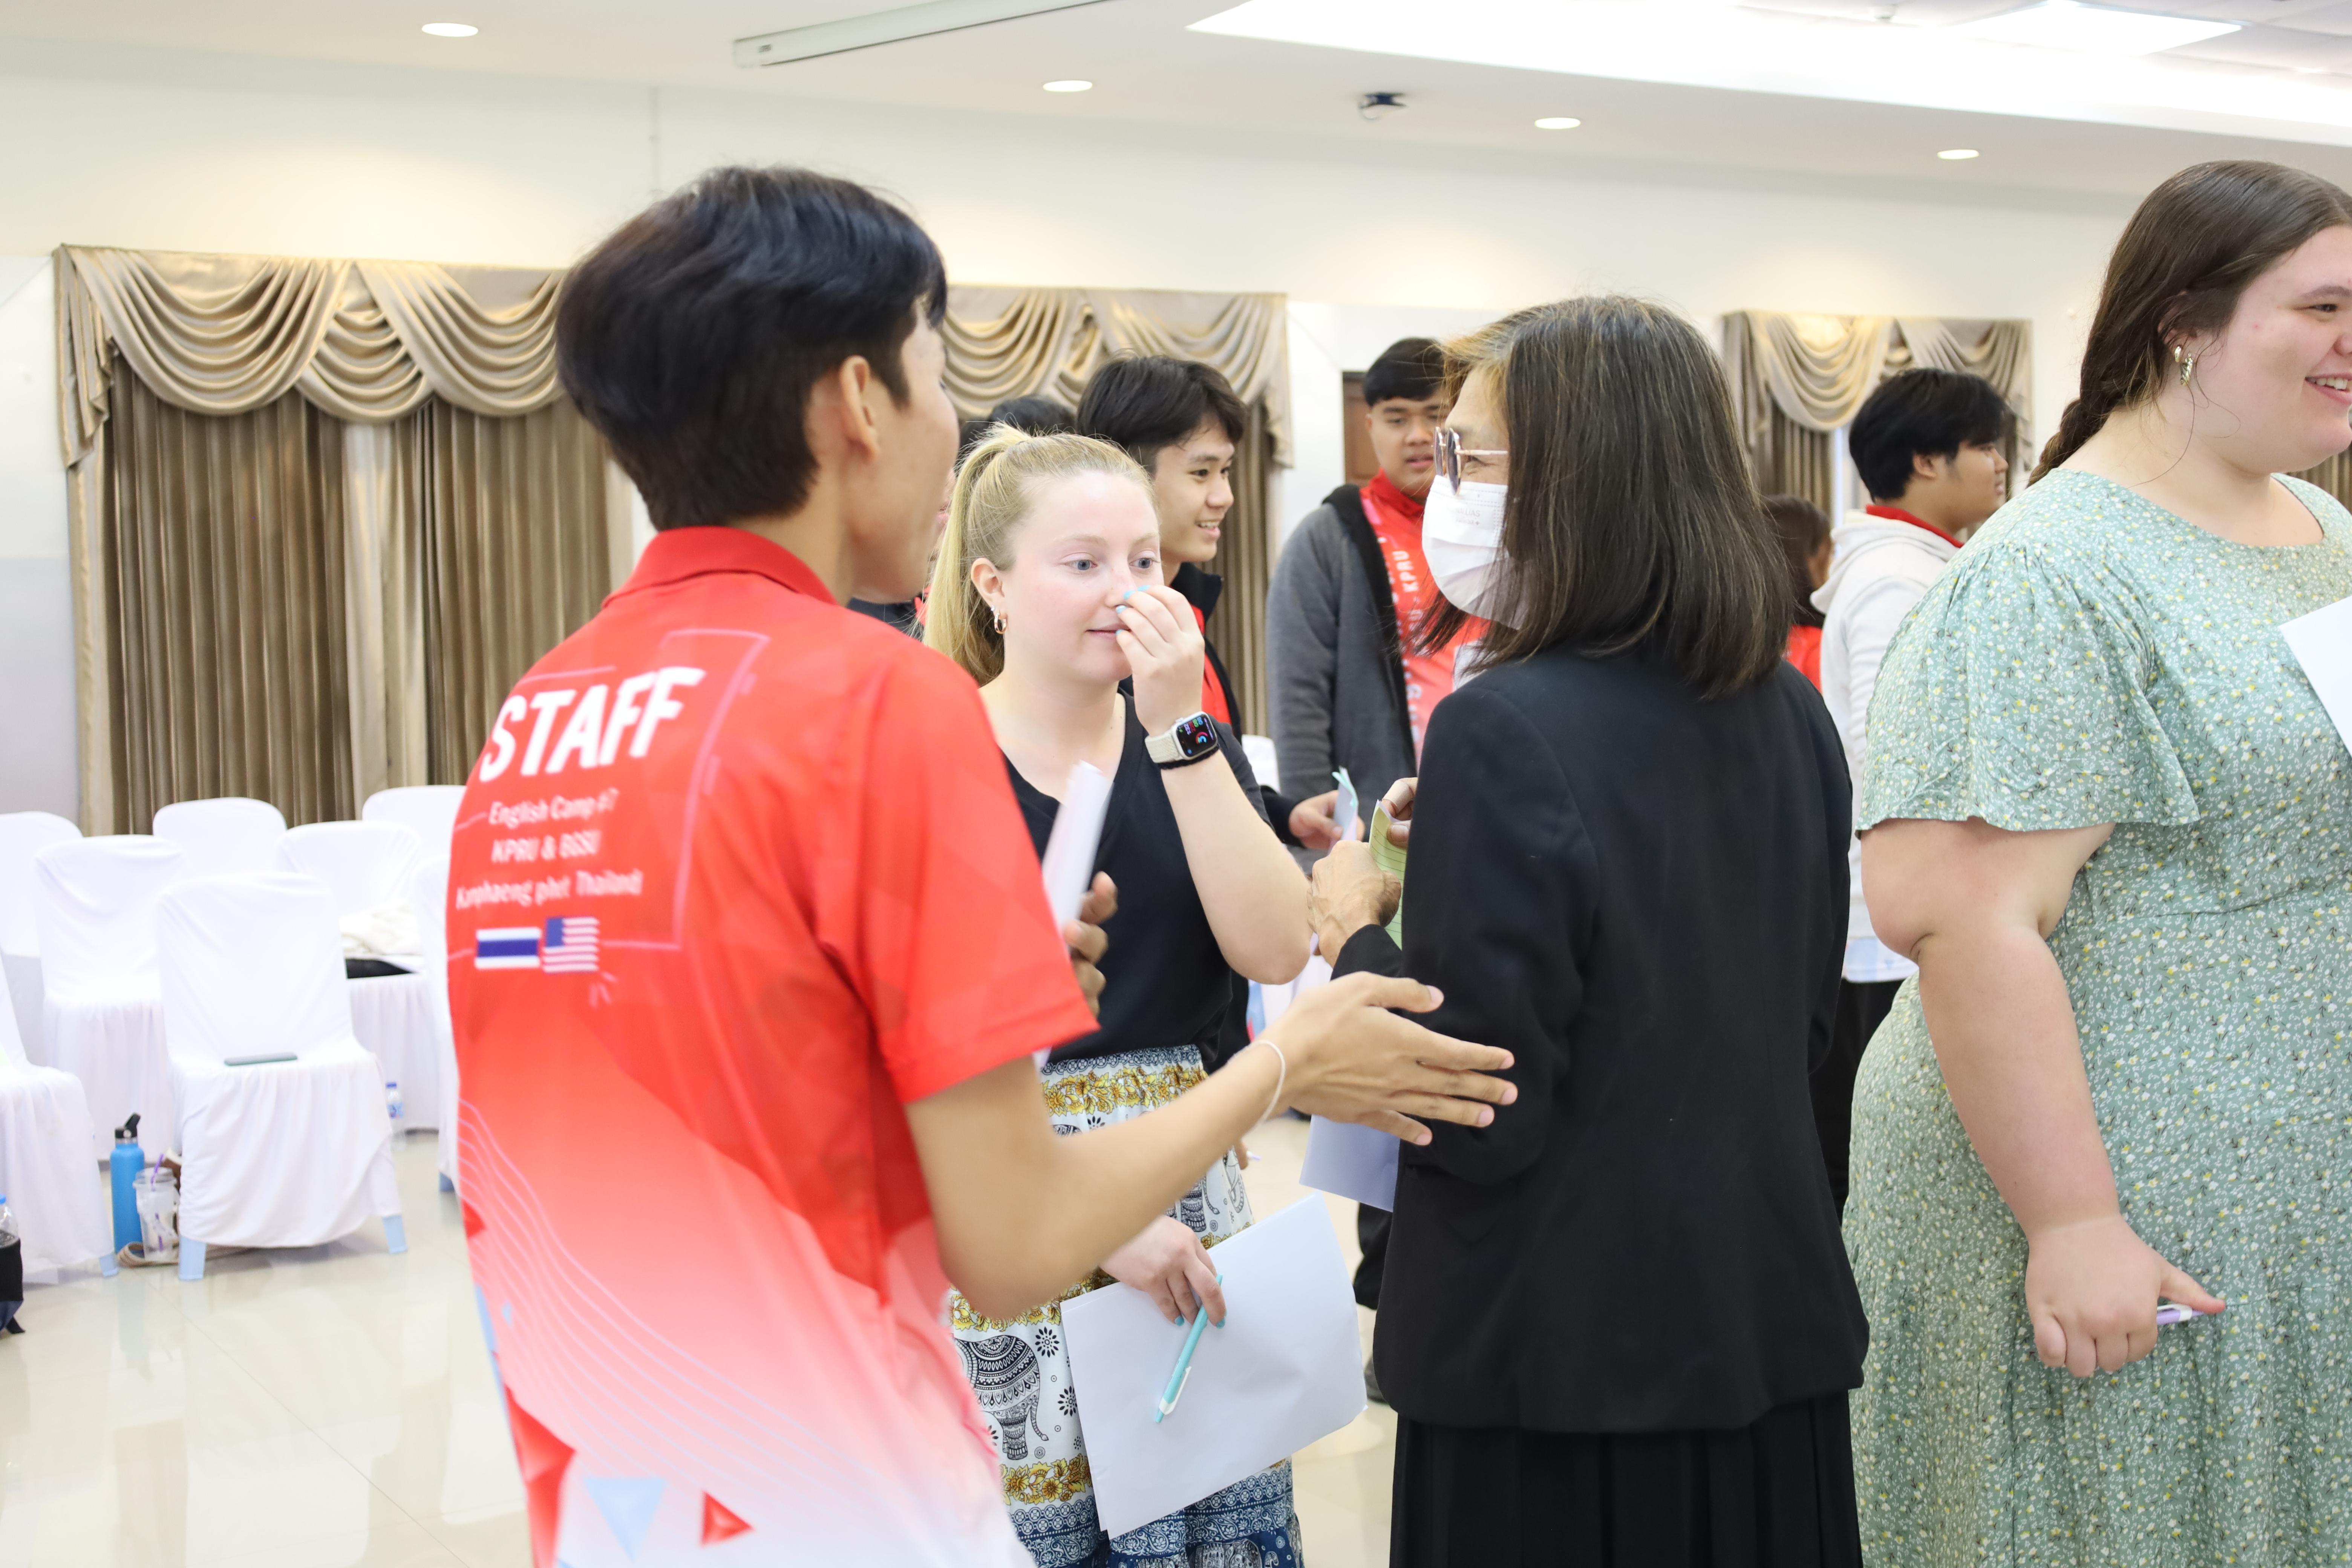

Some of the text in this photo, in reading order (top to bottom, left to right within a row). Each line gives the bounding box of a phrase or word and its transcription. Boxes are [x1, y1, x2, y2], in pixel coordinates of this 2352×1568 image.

[1392, 550, 1420, 592] KPRU
[479, 666, 706, 782] STAFF
[489, 799, 548, 829] English
[550, 795, 596, 820] Camp
